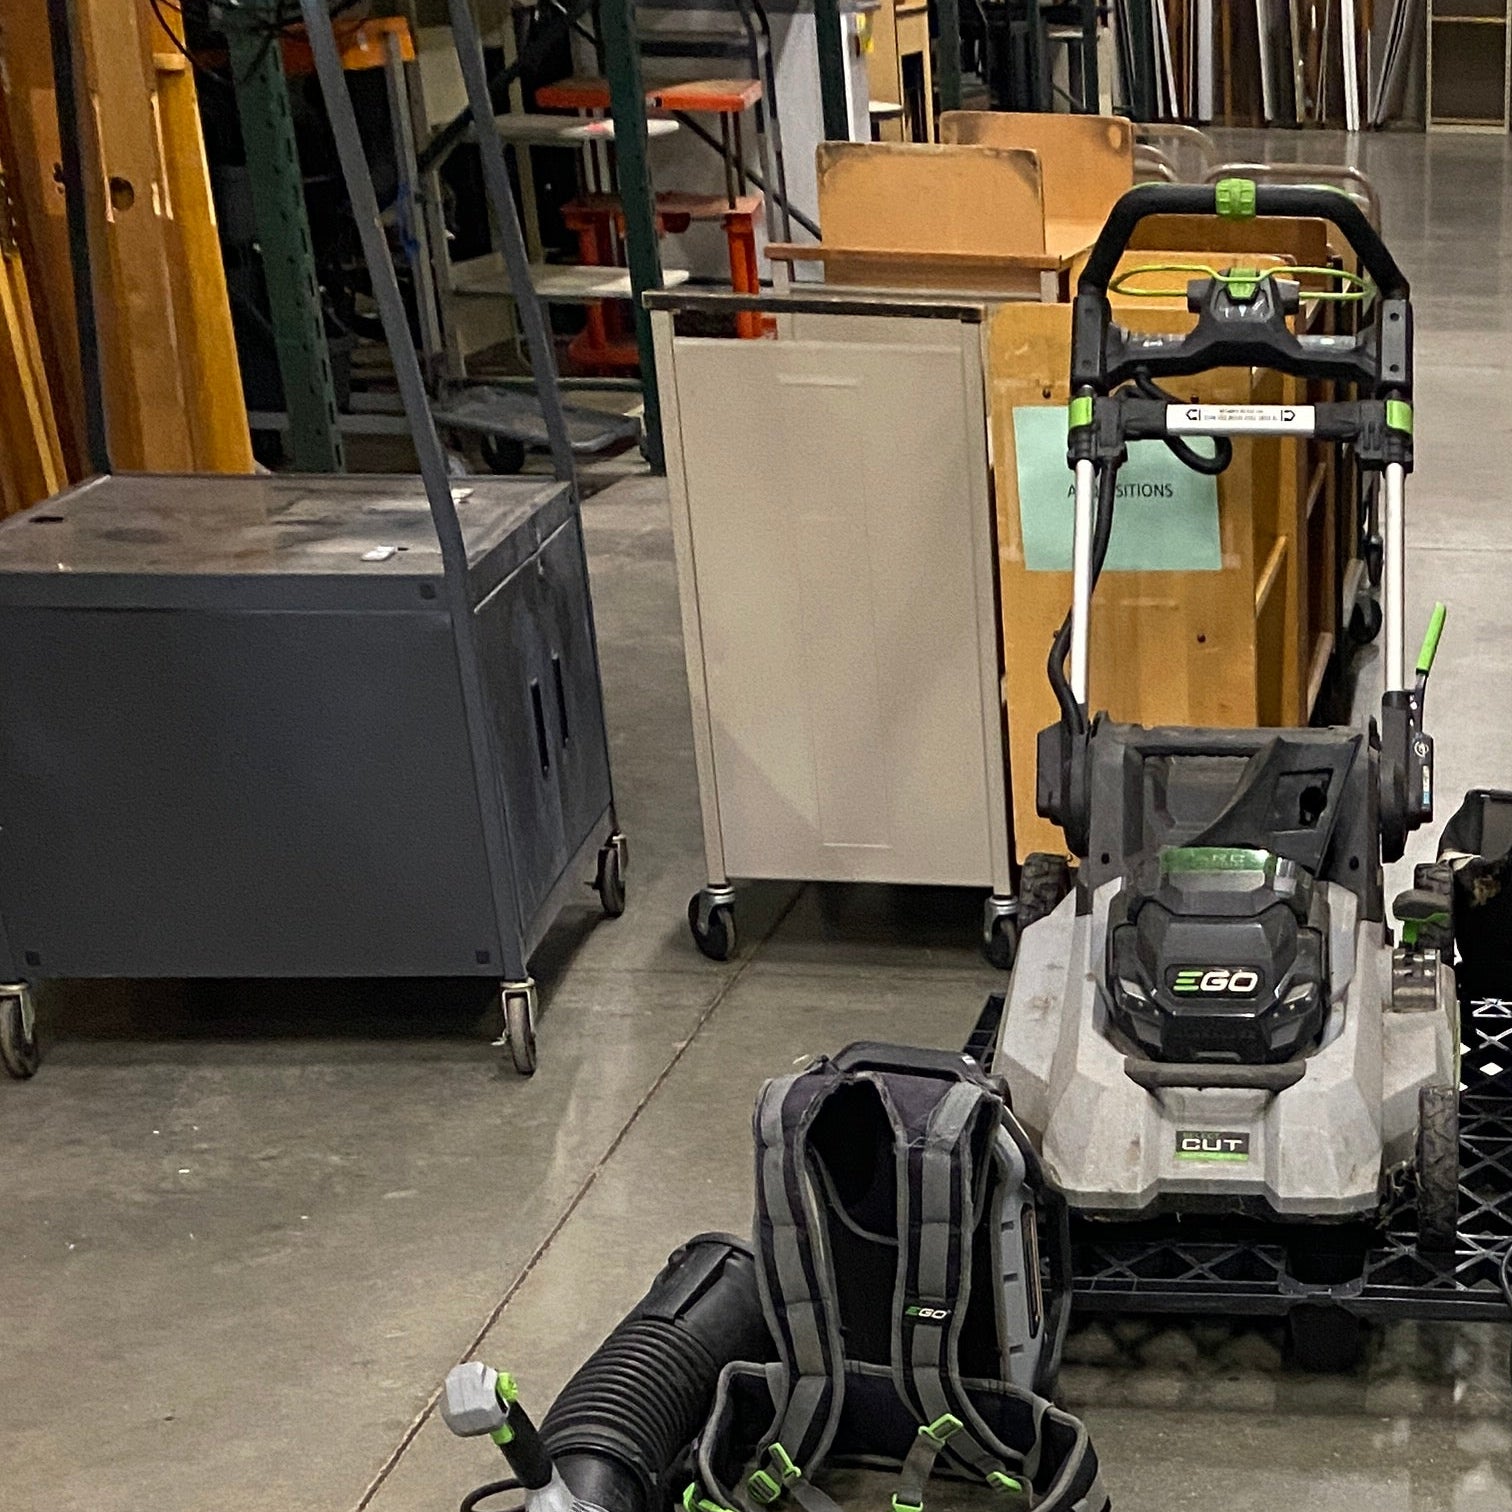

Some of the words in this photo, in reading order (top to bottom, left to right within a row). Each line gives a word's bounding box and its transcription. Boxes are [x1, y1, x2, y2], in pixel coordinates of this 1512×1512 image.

[1068, 483, 1174, 498] ASITIONS
[1173, 970, 1259, 992] EGO
[1182, 1138, 1244, 1152] CUT
[905, 1306, 948, 1320] EGO
